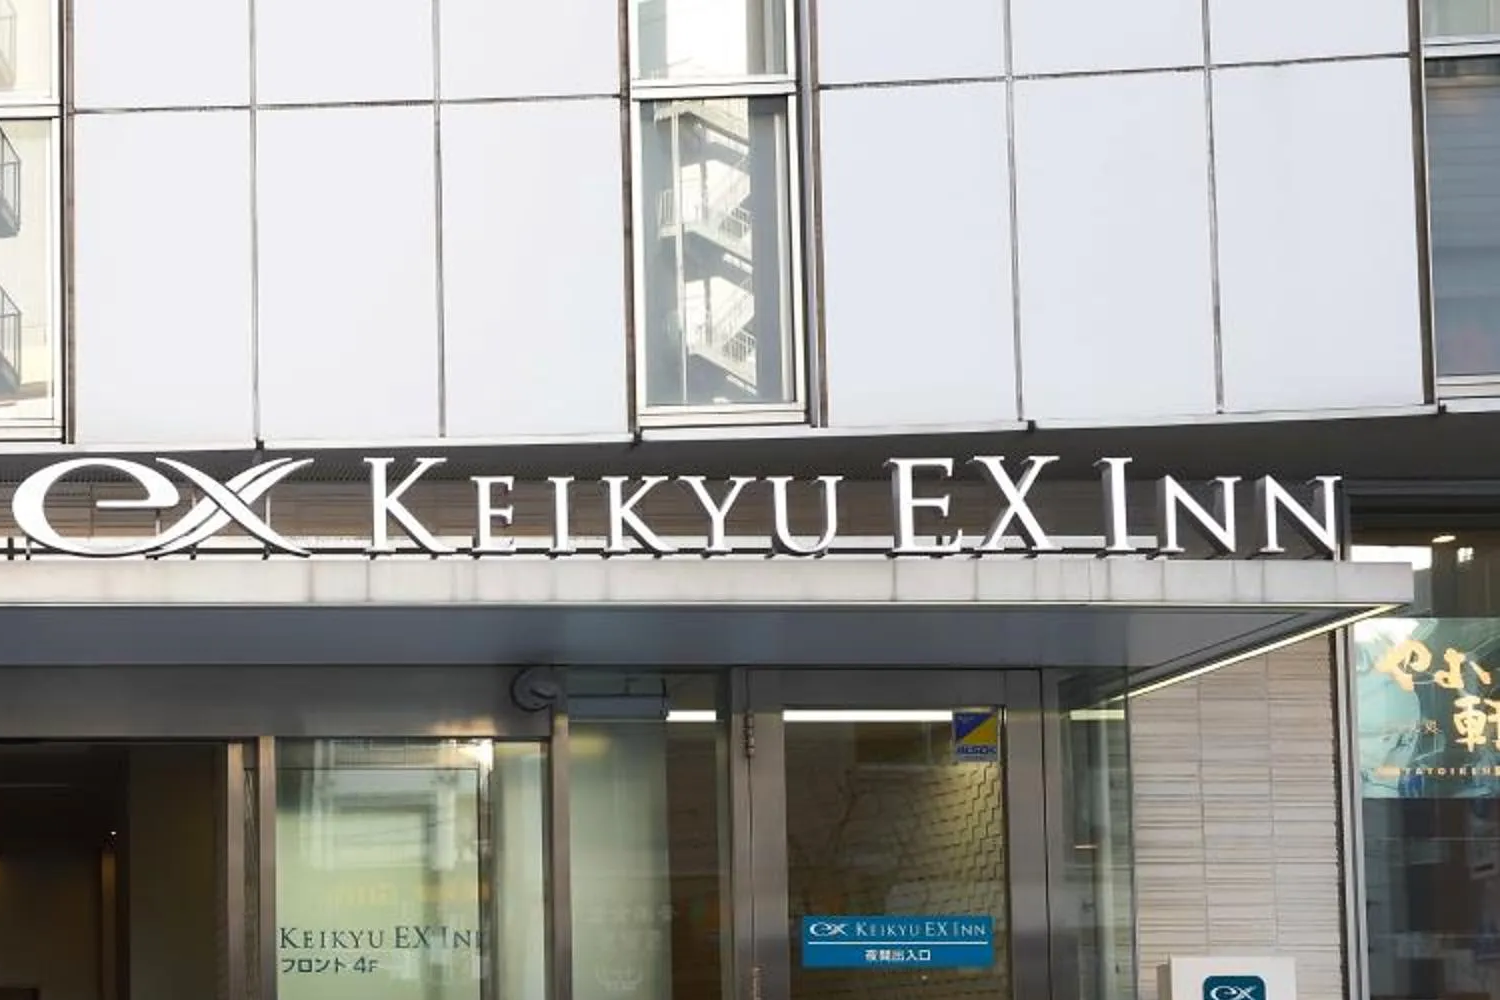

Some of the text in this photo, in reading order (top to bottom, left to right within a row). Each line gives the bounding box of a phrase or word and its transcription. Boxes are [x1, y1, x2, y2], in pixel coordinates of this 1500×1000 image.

[363, 457, 844, 554] KEIKYU
[884, 456, 1061, 553] EX
[1094, 457, 1342, 556] INN
[279, 927, 385, 949] KEIKYU
[394, 926, 432, 949] EX
[855, 922, 920, 937] KEIKYU
[925, 921, 948, 937] EX
[953, 922, 986, 937] INN
[281, 958, 346, 973] フロント
